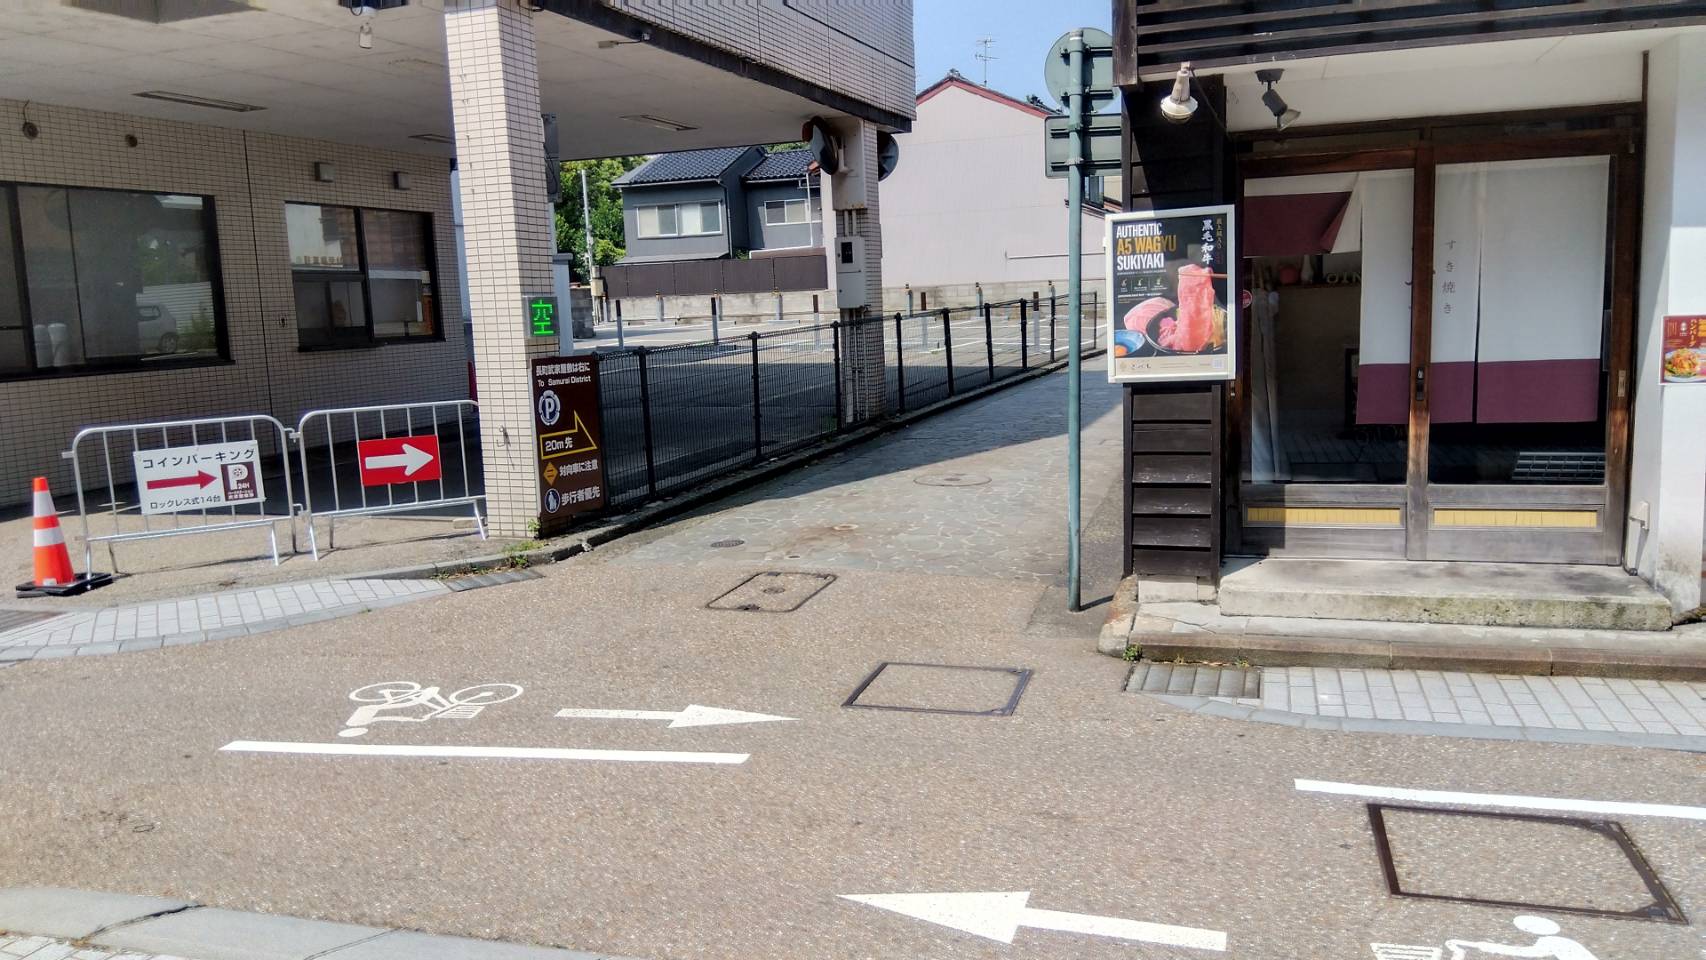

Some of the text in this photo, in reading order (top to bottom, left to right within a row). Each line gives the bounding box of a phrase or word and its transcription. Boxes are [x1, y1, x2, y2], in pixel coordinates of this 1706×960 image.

[1116, 222, 1162, 239] AUTHENTIC
[1117, 235, 1176, 255] A5 WAGYU
[1201, 219, 1214, 264] 黒毛和牛
[1117, 253, 1164, 271] SUKIYAKI
[1441, 239, 1457, 314] すき焼き
[531, 299, 554, 334] 空
[537, 375, 591, 387] To Samurai District
[545, 397, 555, 419] P
[143, 448, 255, 469] コインパーキング
[559, 459, 598, 477] 対向車に注意
[227, 464, 249, 490] P
[150, 494, 221, 509] ロックレス式14台
[561, 486, 601, 506] 歩行者優先
